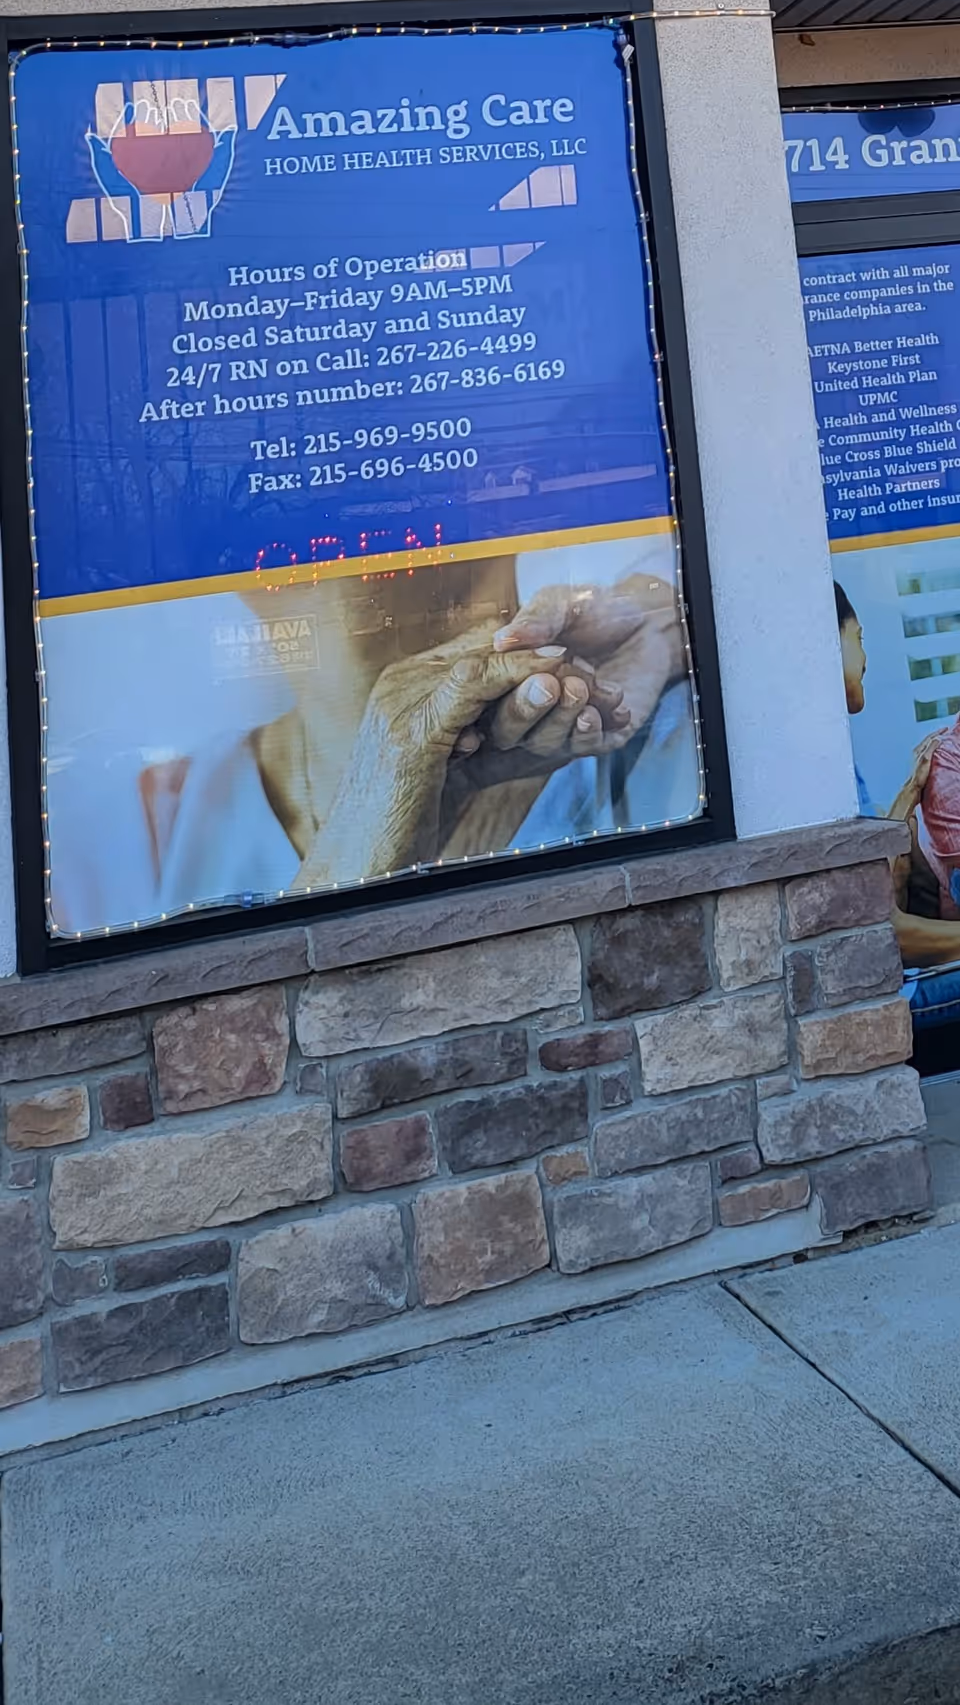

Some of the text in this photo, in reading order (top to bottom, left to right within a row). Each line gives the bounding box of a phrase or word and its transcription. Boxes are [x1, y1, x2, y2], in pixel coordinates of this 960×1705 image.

[266, 94, 575, 140] Amazing Care
[264, 138, 587, 176] HOME HEALTH SERVICES, LLC
[228, 249, 467, 287] Hours of Operation
[803, 262, 951, 287] contract with all major
[844, 279, 954, 306] companies the
[808, 301, 926, 322] Philadelphia area.
[172, 304, 527, 355] Closed Saturday and Sunday
[854, 332, 940, 353] Better Health
[166, 332, 538, 390] 24/7 RN on Call: 267-226-4499
[827, 352, 921, 376] Keystone First
[138, 359, 566, 423] After hours number: 267-836-6169
[814, 369, 938, 393] United Health Plan
[858, 391, 898, 406] UPMC
[823, 413, 868, 429] Health
[871, 409, 896, 423] and
[899, 402, 957, 420] Wellness
[250, 417, 472, 461] Tel: 215-969-9500
[828, 427, 906, 447] Community
[909, 422, 953, 437] Health
[845, 437, 957, 462] Cross Blue Shield
[249, 448, 478, 494] Fax: 215-696-4500
[884, 459, 937, 476] Waivers
[837, 477, 940, 501] Health Partners
[832, 507, 856, 522] Pay
[860, 501, 886, 516] and
[889, 497, 924, 513] other
[255, 522, 441, 592] OPEN
